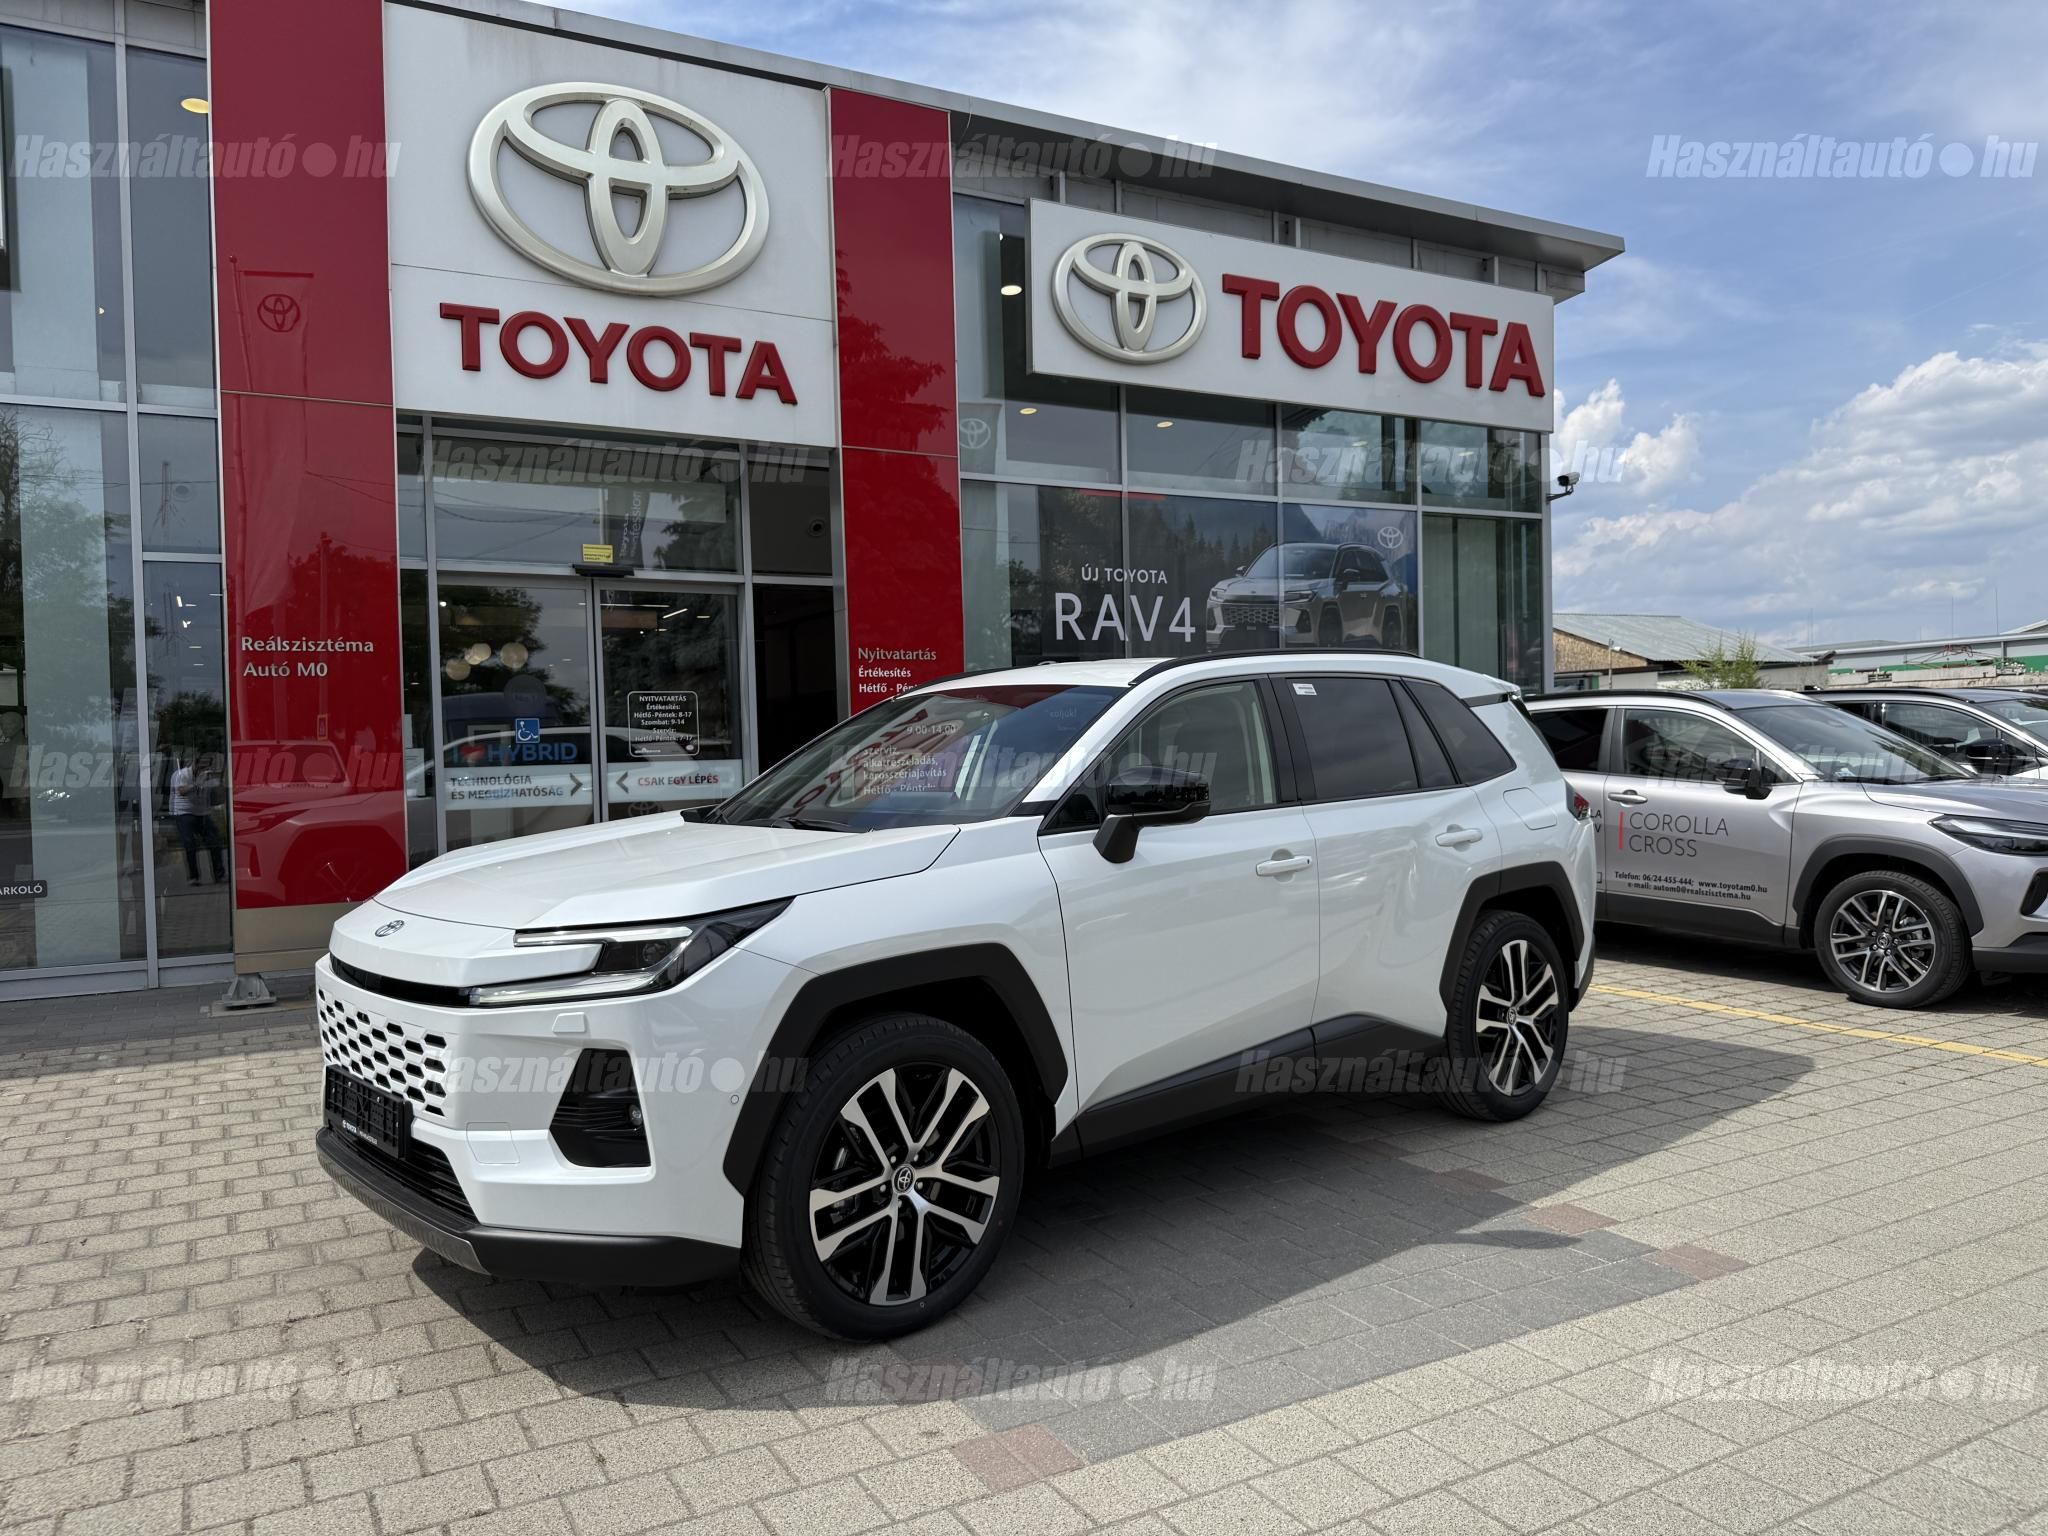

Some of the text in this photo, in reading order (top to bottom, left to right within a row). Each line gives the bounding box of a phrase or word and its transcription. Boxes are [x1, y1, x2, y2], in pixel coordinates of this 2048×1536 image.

[1222, 273, 1545, 397] TOYOTA
[440, 302, 797, 406] TOYOTA
[1081, 563, 1168, 584] ÚJ TOYOTA
[1055, 592, 1196, 643] RAV4
[241, 635, 374, 652] Reálszisztéma
[858, 647, 937, 663] Nyitvatartás
[243, 661, 291, 677] Autó
[858, 665, 912, 678] Értékesítés
[859, 683, 888, 693] Hétfő
[896, 683, 918, 693] Pén
[639, 694, 687, 702] NYITVATARTÁS
[488, 742, 577, 761] HYBRID
[638, 773, 719, 786] CSAK EGY LÉPÉS
[451, 790, 465, 801] ÉS
[1629, 811, 1729, 837] COROLLA
[1628, 834, 1697, 858] CROSS
[1615, 872, 1641, 881] Telefon:
